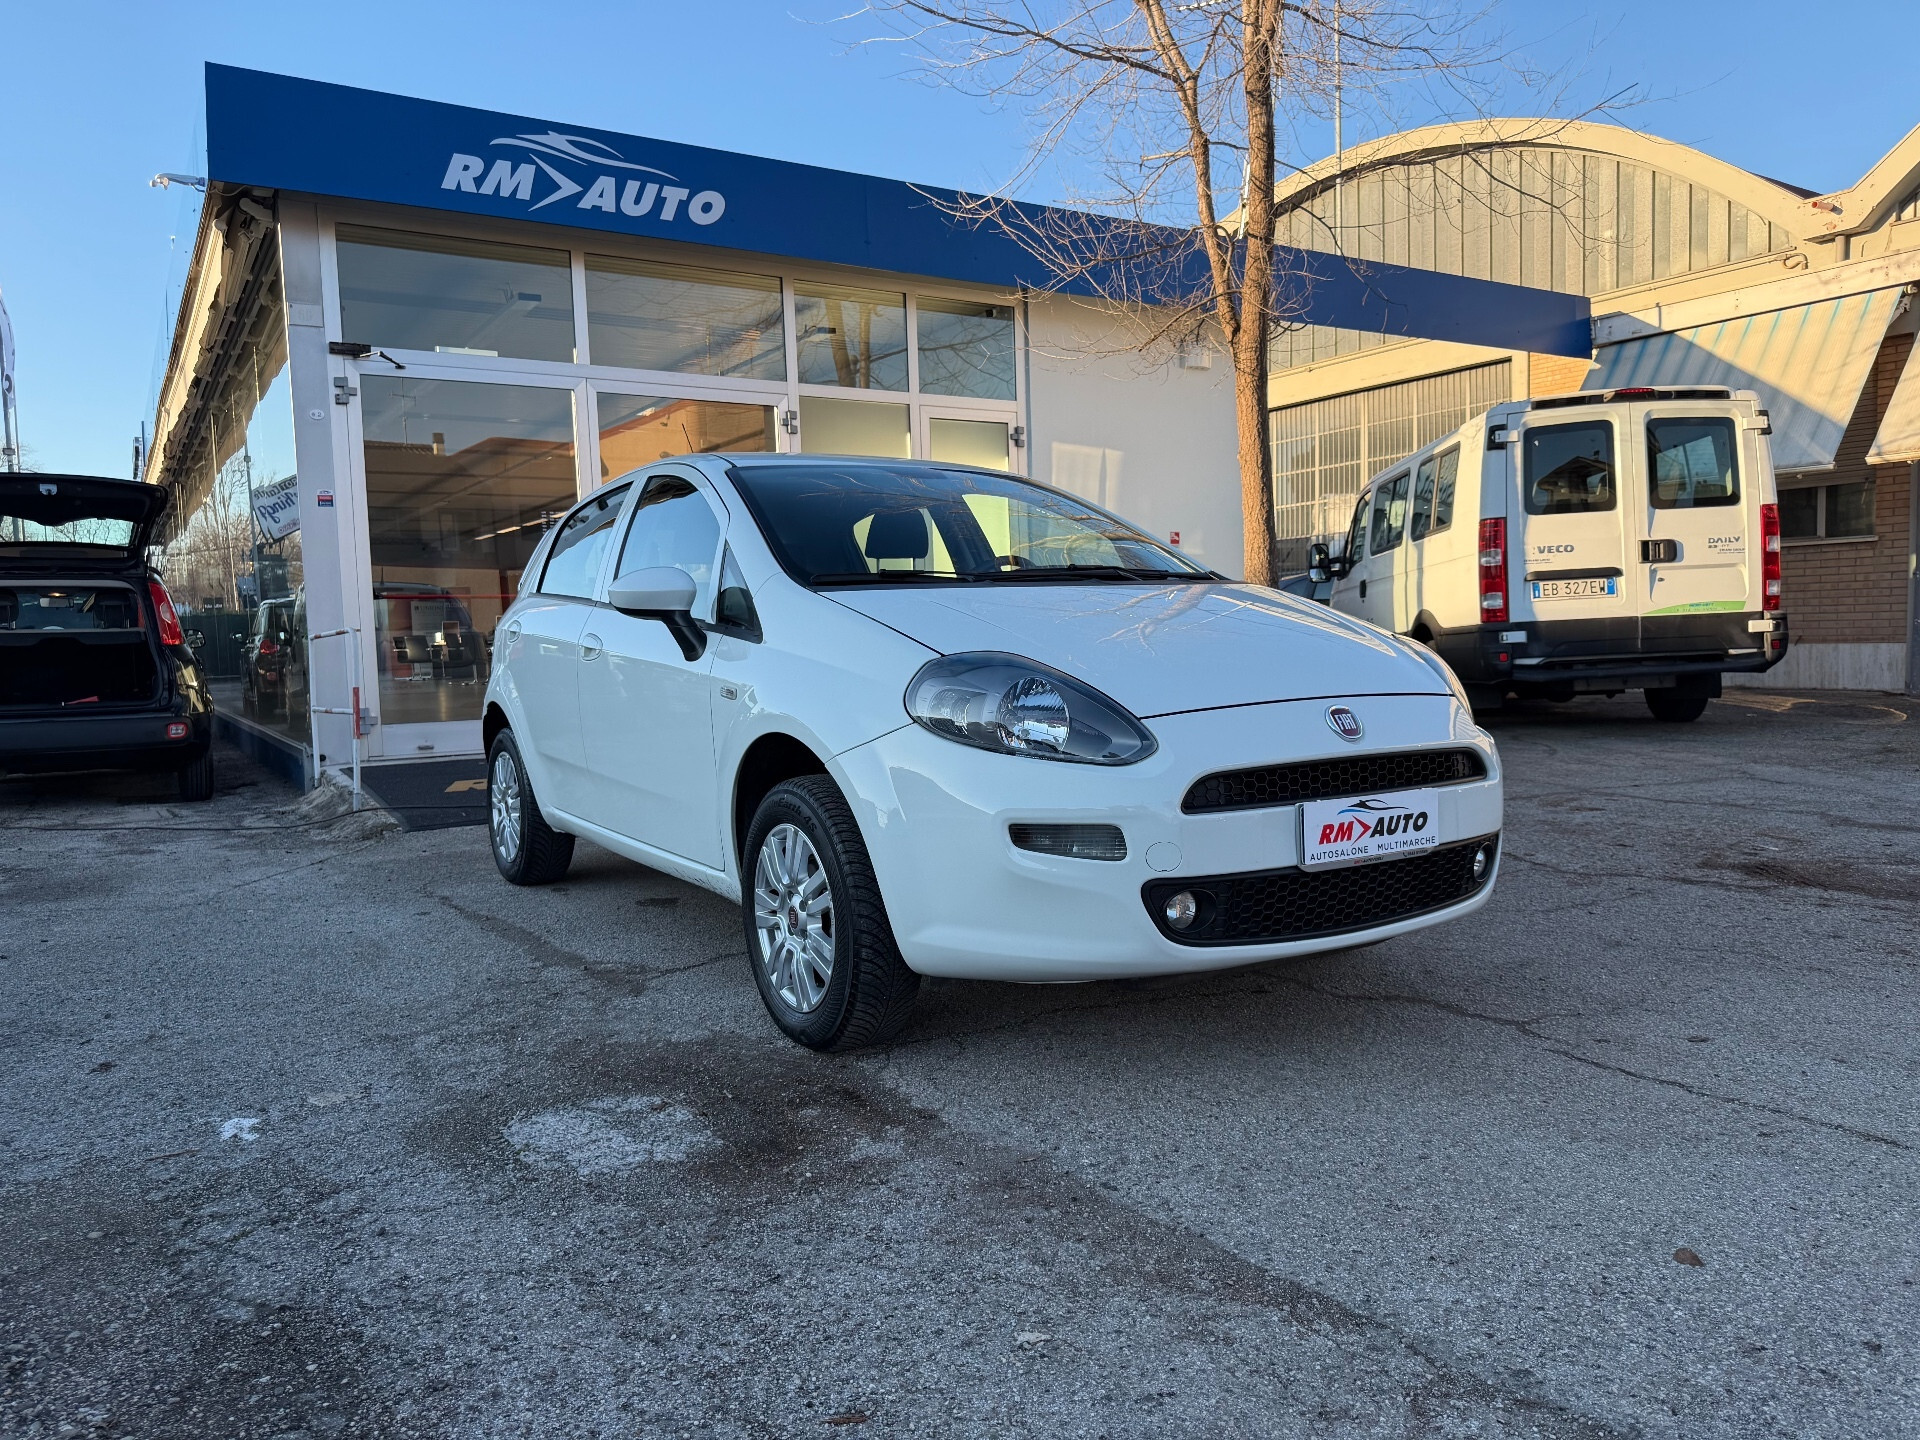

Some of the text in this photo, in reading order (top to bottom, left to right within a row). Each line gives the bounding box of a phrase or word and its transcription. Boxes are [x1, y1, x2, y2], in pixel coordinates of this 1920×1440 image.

[576, 175, 726, 226] AUTO
[1533, 544, 1575, 554] VECO
[1708, 536, 1740, 544] DAILY
[1542, 583, 1559, 597] EB
[1334, 713, 1357, 731] FIAT
[1318, 811, 1428, 846] RM AUTO
[1309, 845, 1369, 862] AUTOSALONE
[1377, 835, 1436, 852] MULTIMARCHE
